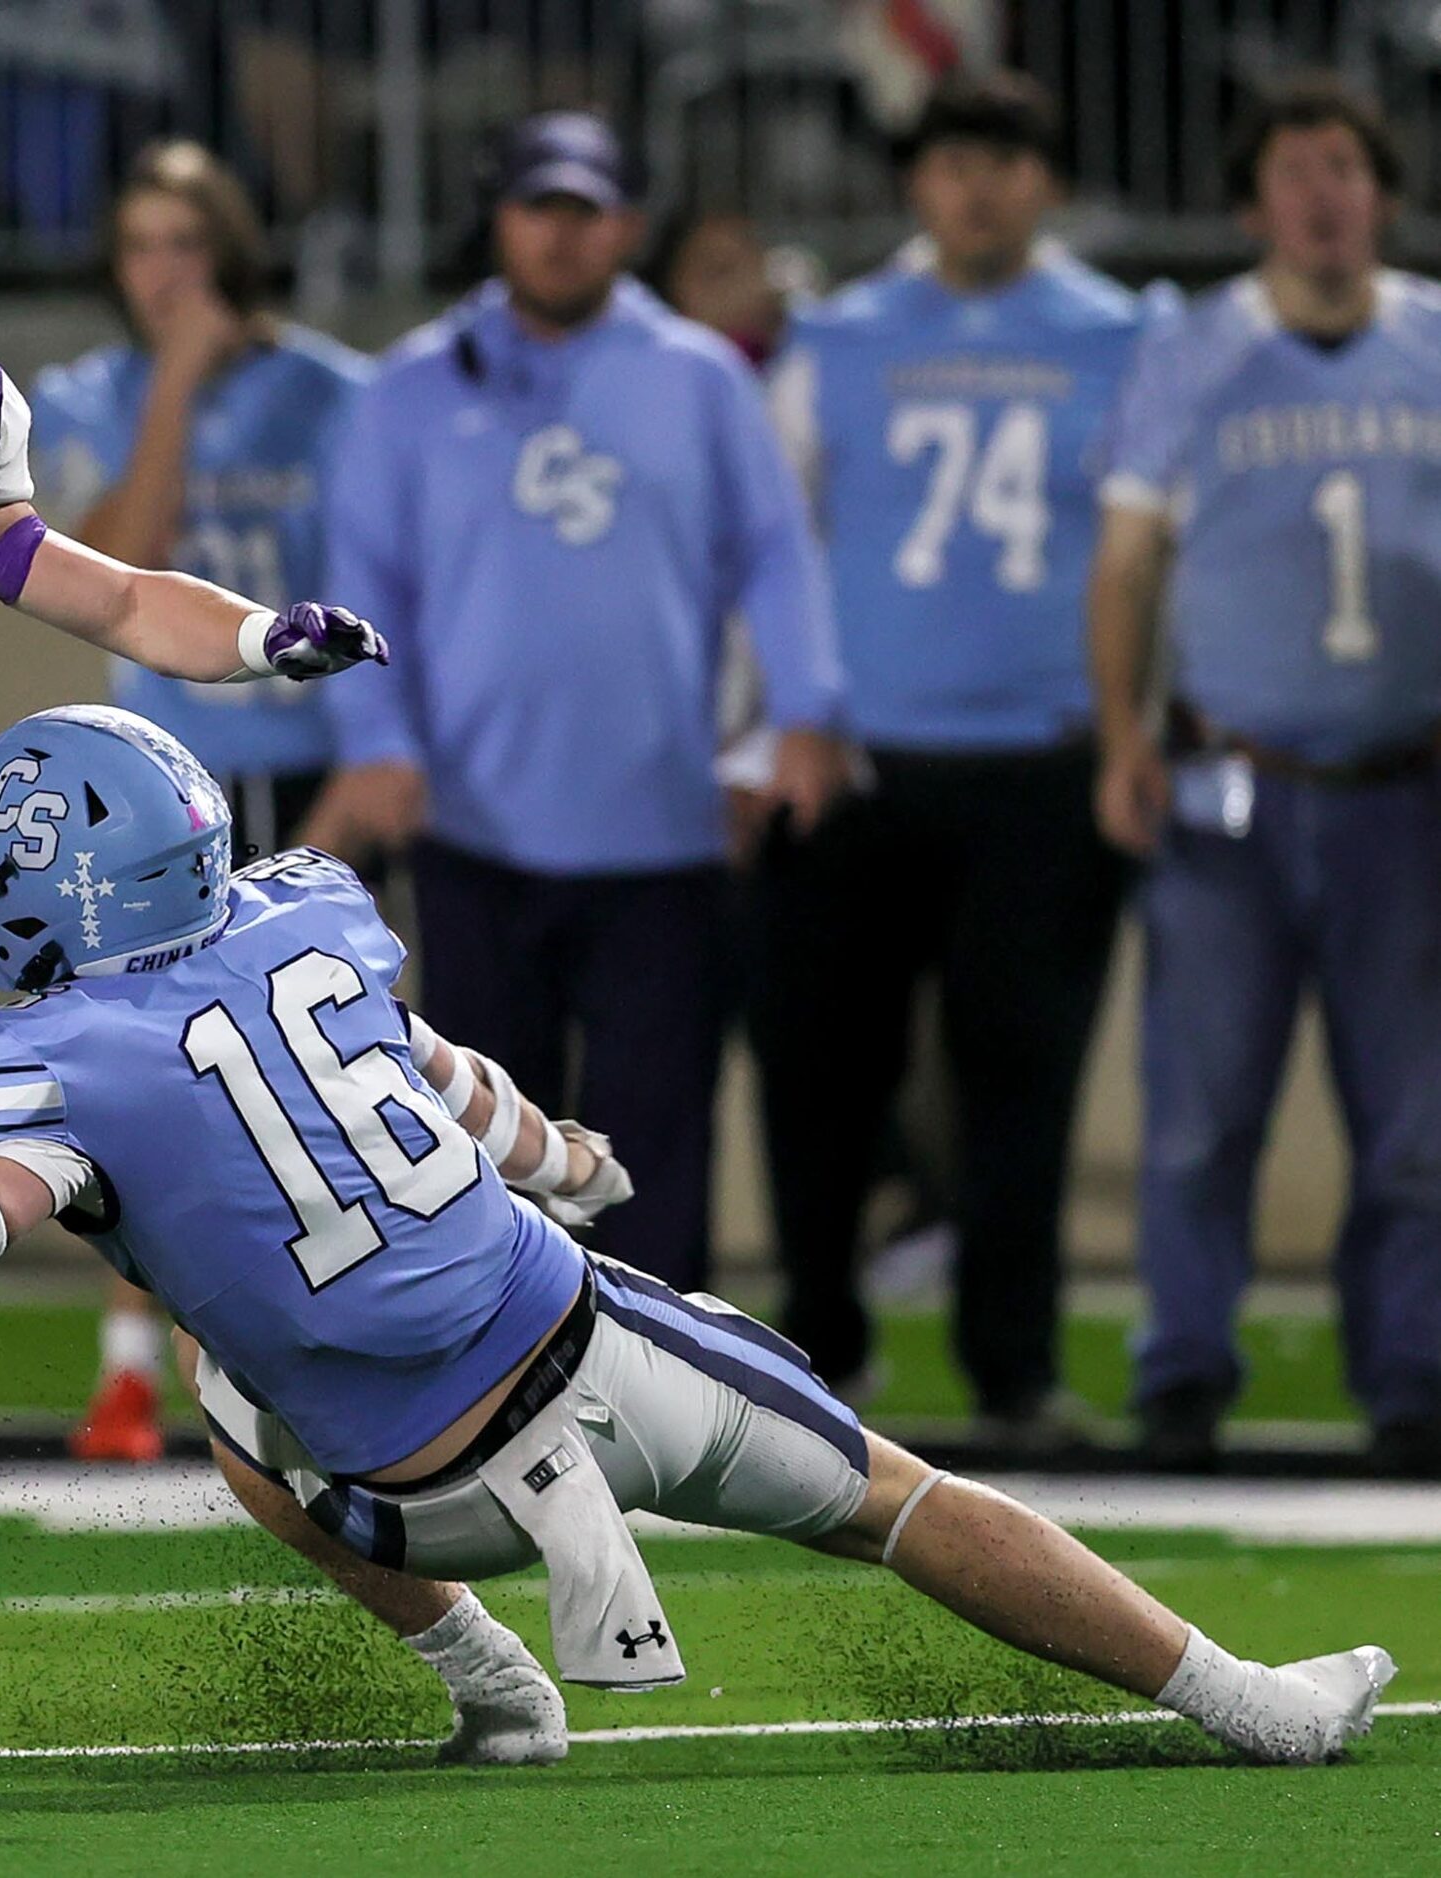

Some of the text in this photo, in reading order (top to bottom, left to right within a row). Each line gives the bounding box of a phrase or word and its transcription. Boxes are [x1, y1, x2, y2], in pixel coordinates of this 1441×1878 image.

[515, 424, 623, 546] CS
[886, 404, 1052, 592] 74
[1313, 468, 1382, 666] 1
[124, 944, 194, 974] CHINA
[178, 947, 483, 1295] 16
